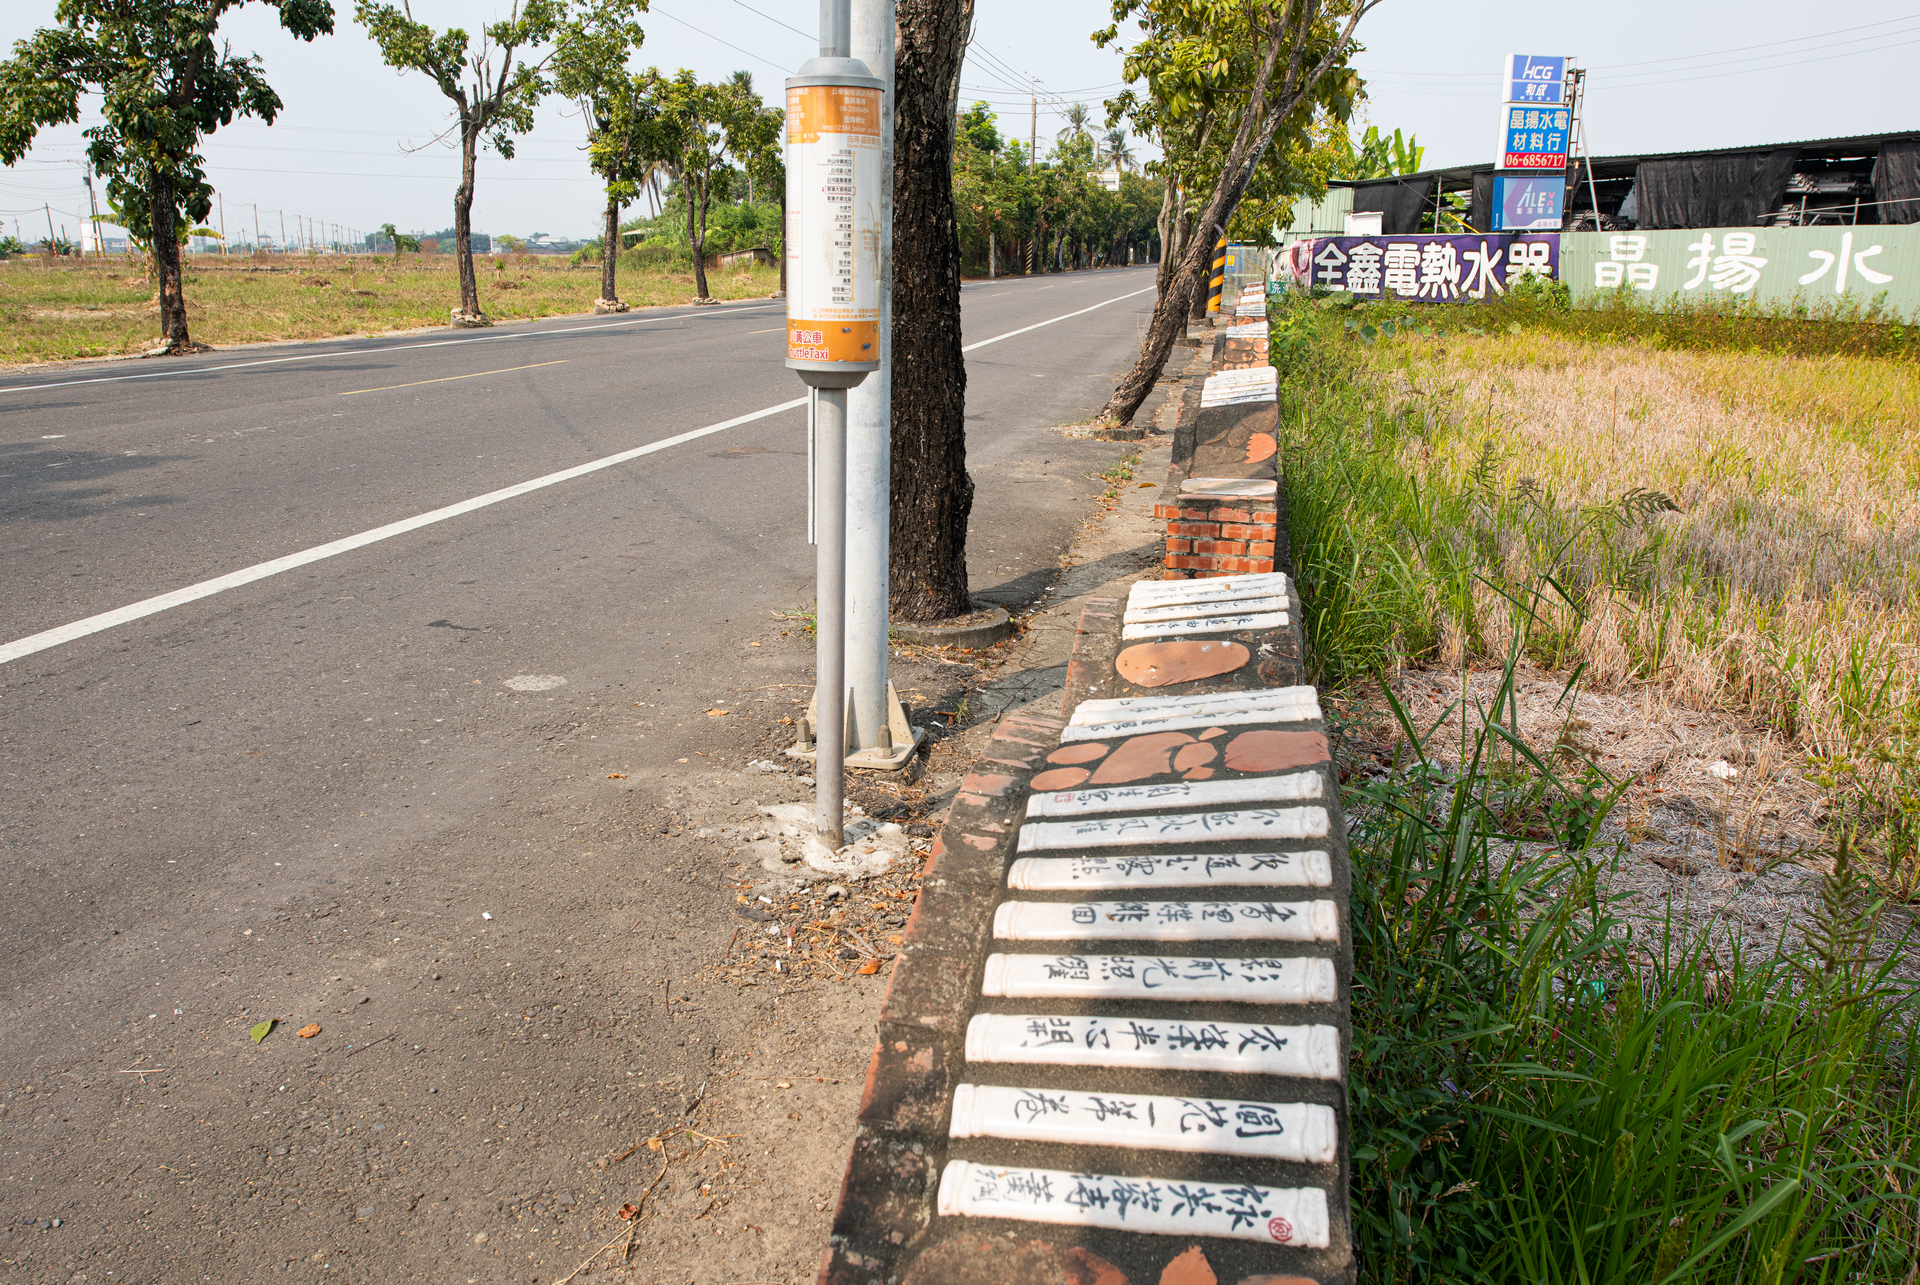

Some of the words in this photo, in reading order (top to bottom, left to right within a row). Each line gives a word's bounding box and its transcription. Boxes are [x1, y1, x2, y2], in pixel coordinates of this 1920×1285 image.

[1522, 55, 1554, 80] HCG
[1525, 83, 1548, 97] 和成
[1510, 110, 1569, 130] 晶揚水電
[1512, 132, 1562, 151] 材料行
[1506, 153, 1565, 167] 06-6856717
[1517, 181, 1556, 207] ALEX
[1594, 231, 1893, 295] 晶揚水
